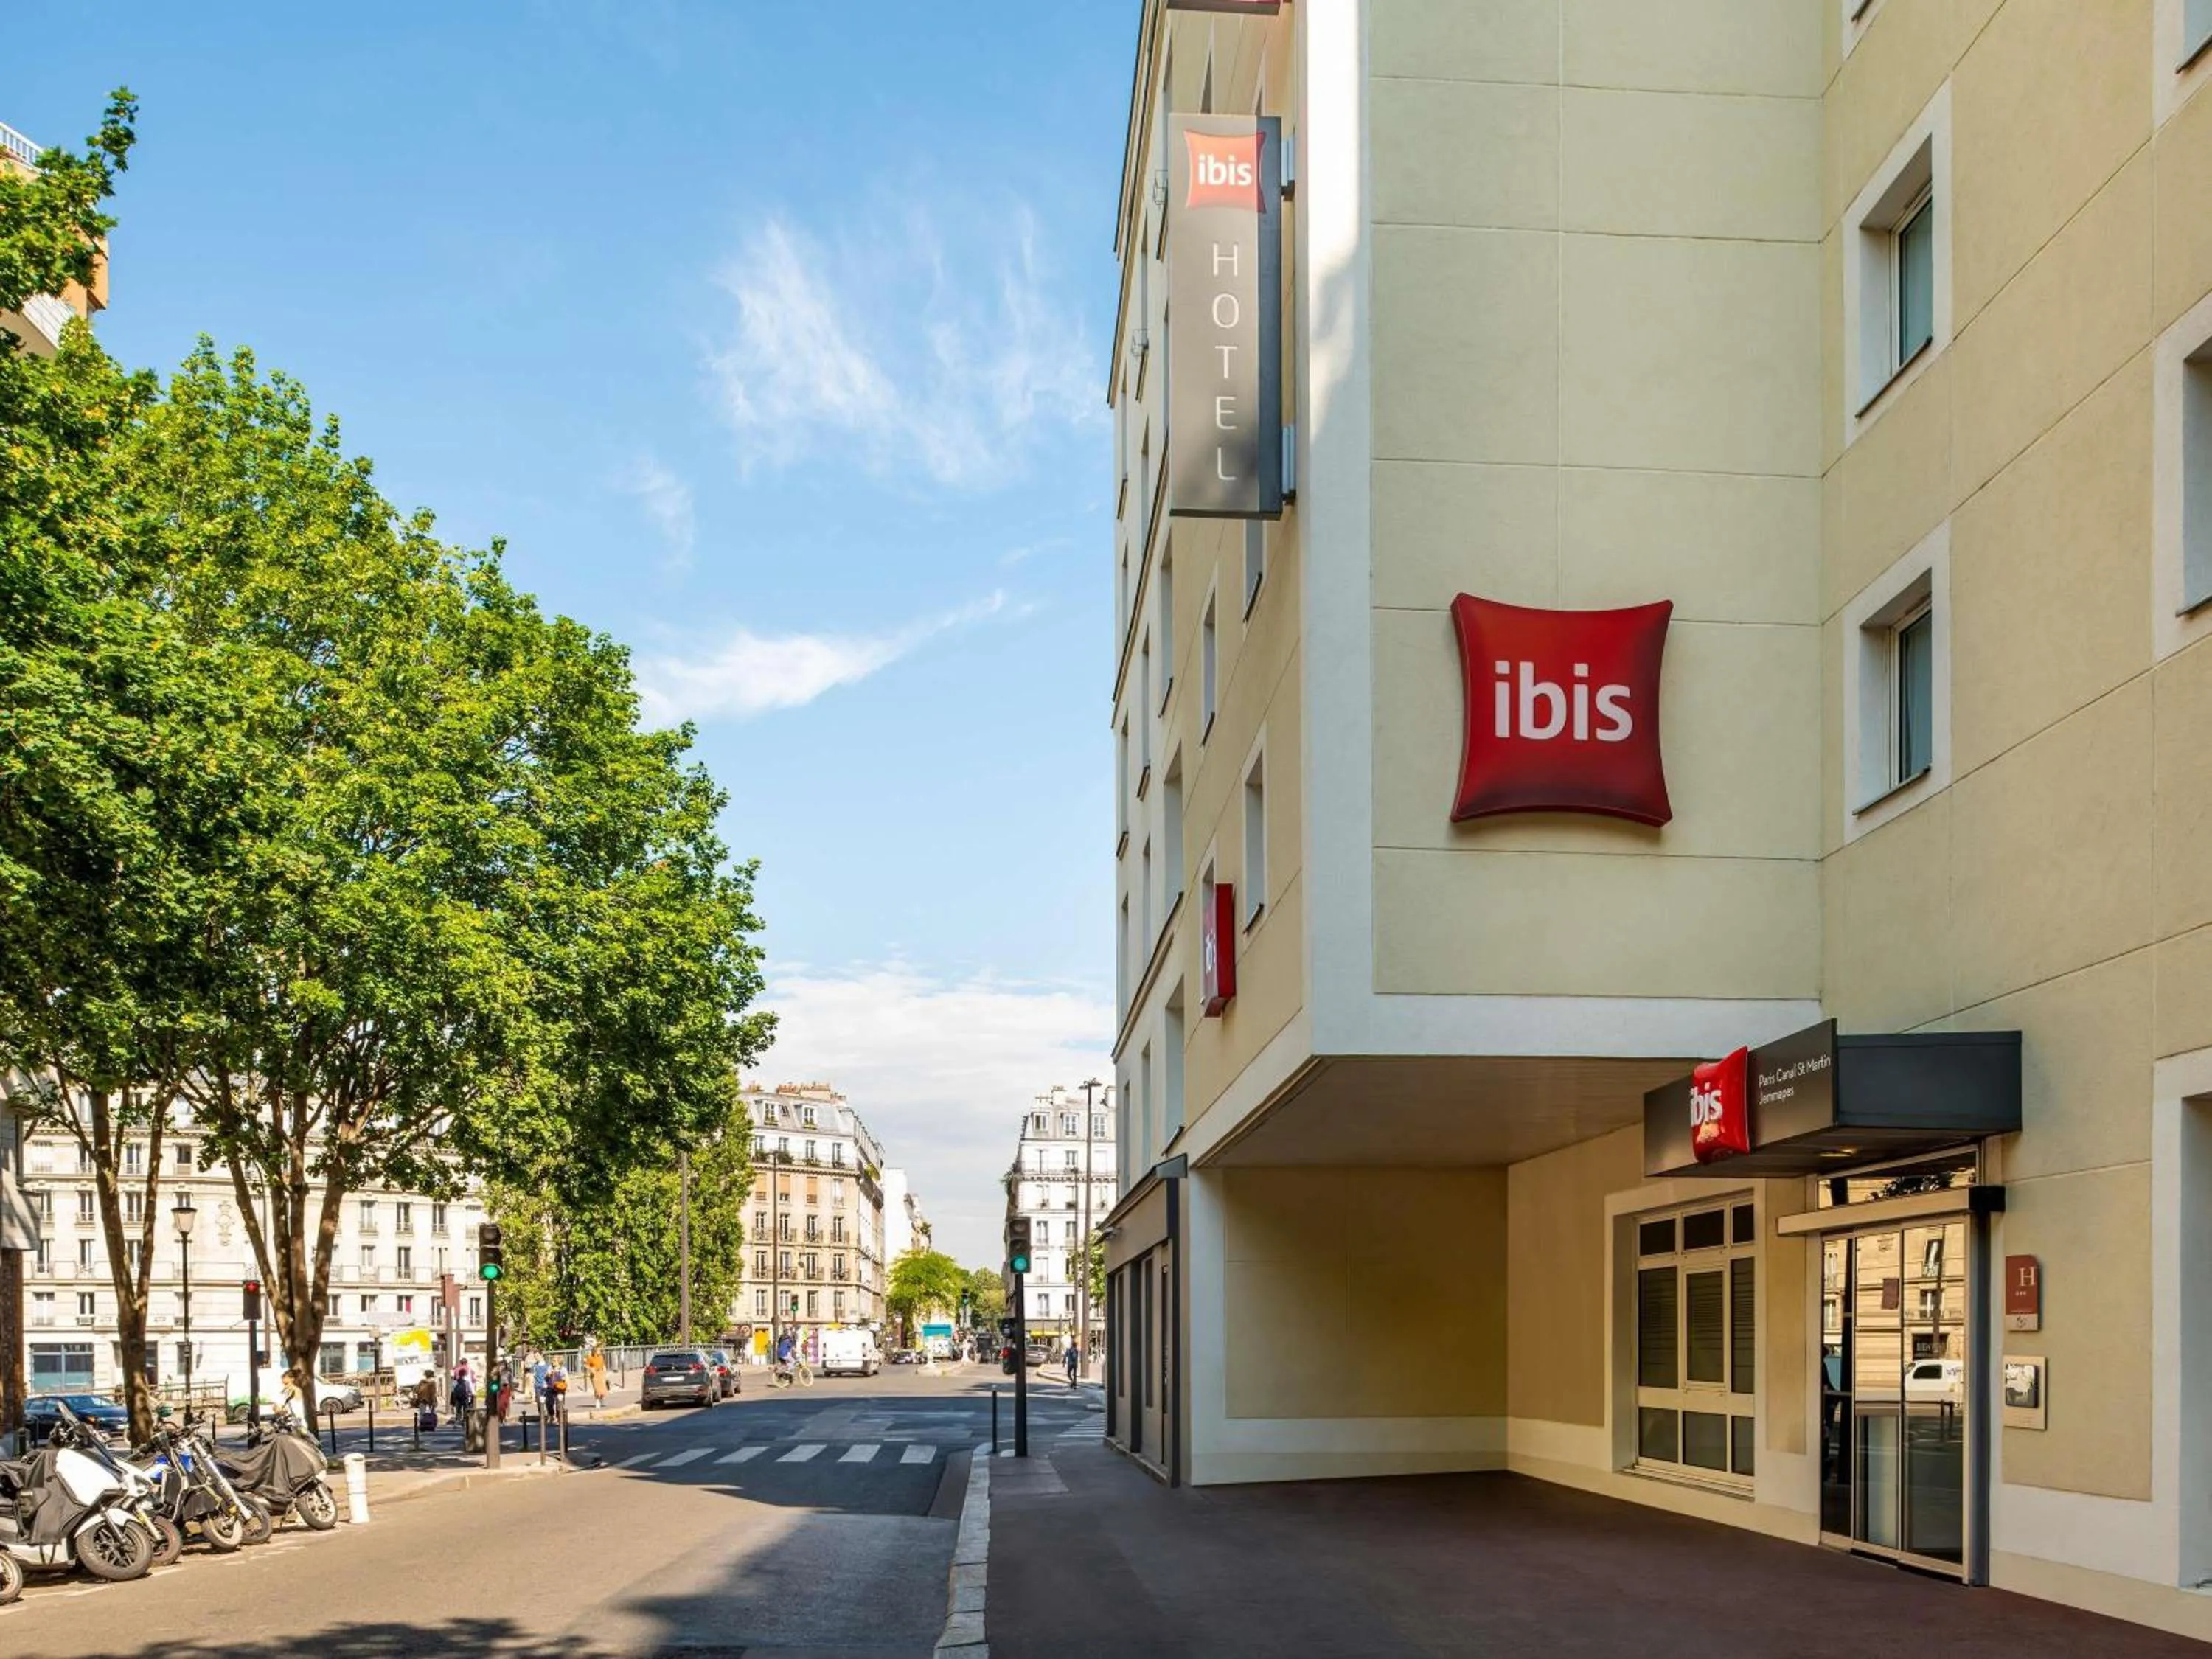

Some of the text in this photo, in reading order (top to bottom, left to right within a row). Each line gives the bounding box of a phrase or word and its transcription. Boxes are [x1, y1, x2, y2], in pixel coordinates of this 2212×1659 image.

[1198, 153, 1252, 186] ibis
[1212, 242, 1240, 480] HOTEL
[1495, 660, 1633, 742] ibis
[1759, 1054, 1831, 1088] Paris Canal St Martin
[1691, 1082, 1722, 1127] ibis
[1759, 1086, 1794, 1105] Jemmapes
[2018, 1267, 2036, 1286] H
